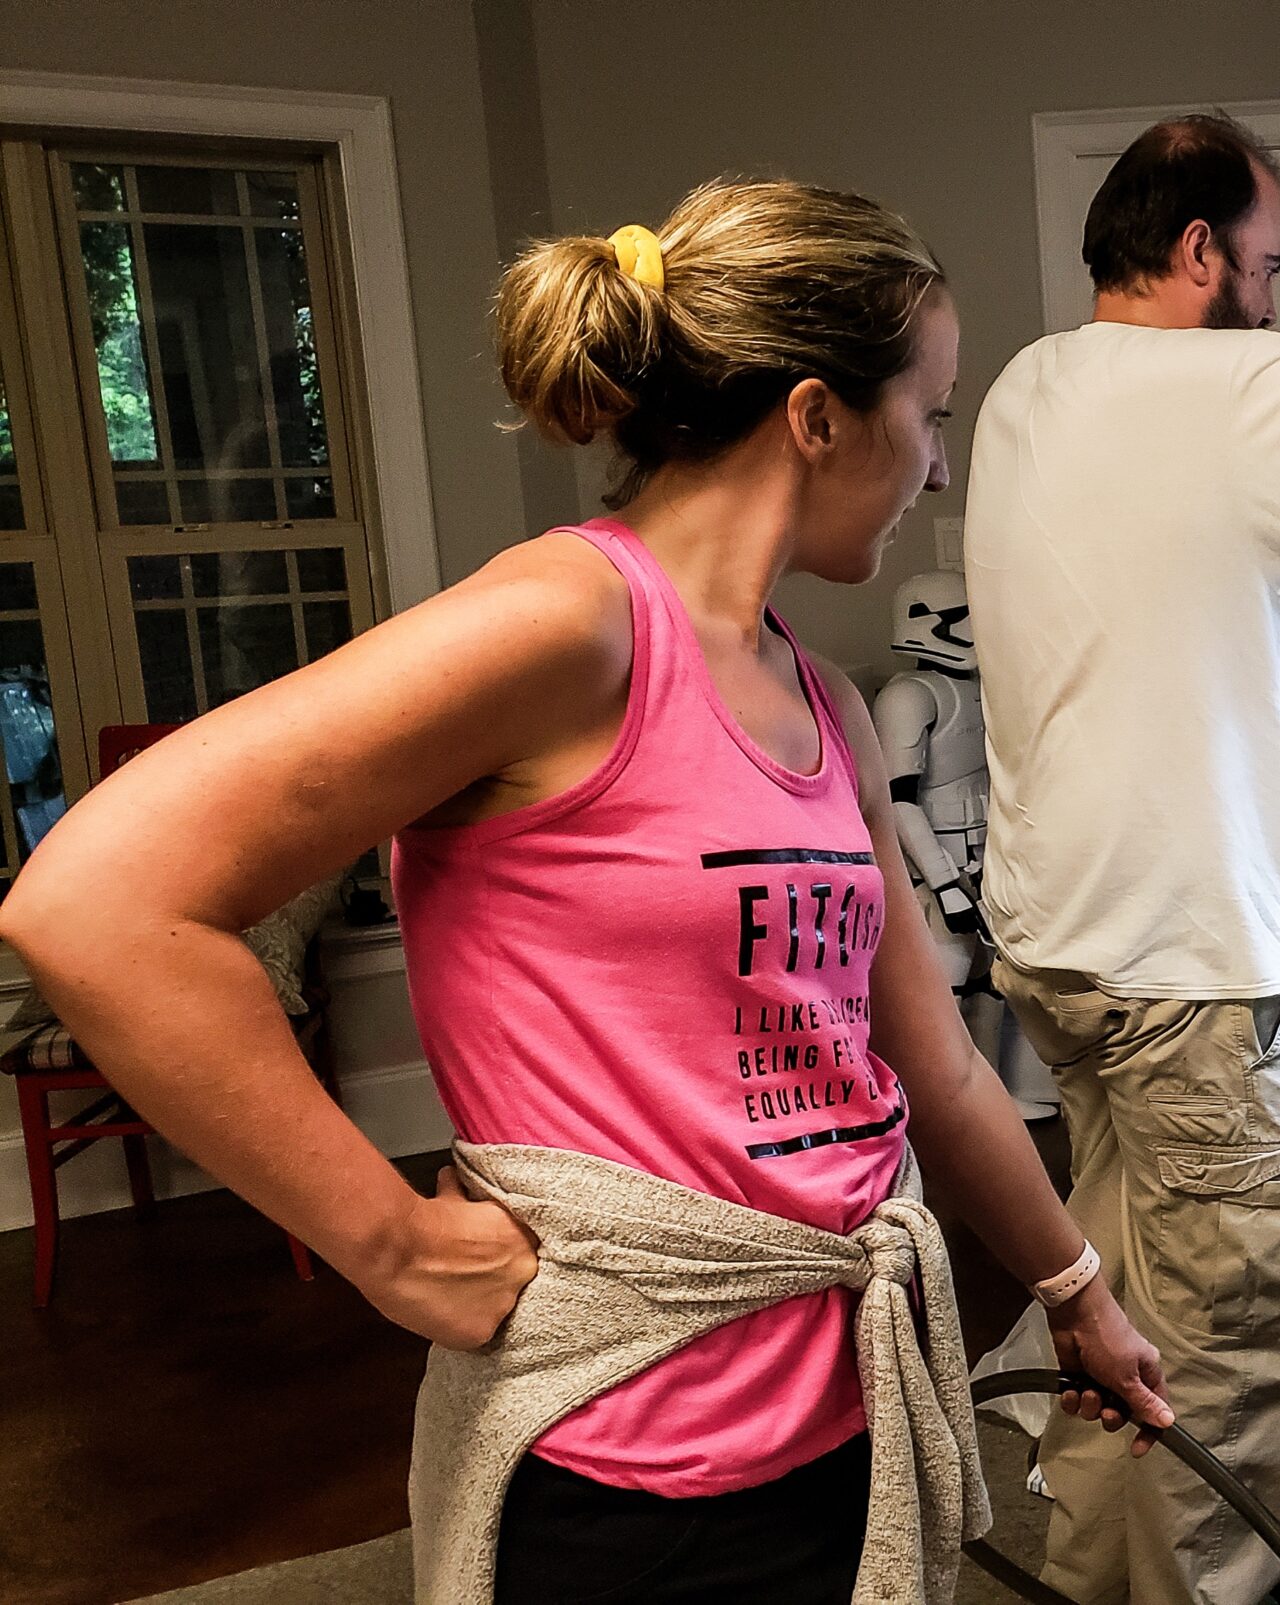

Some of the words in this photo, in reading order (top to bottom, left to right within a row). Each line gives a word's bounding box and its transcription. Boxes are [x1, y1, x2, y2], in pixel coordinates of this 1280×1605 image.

[735, 1006, 742, 1035] I
[759, 1003, 820, 1032] LIKE
[737, 1044, 819, 1079] BEING
[744, 1079, 855, 1123] EQUALLY
